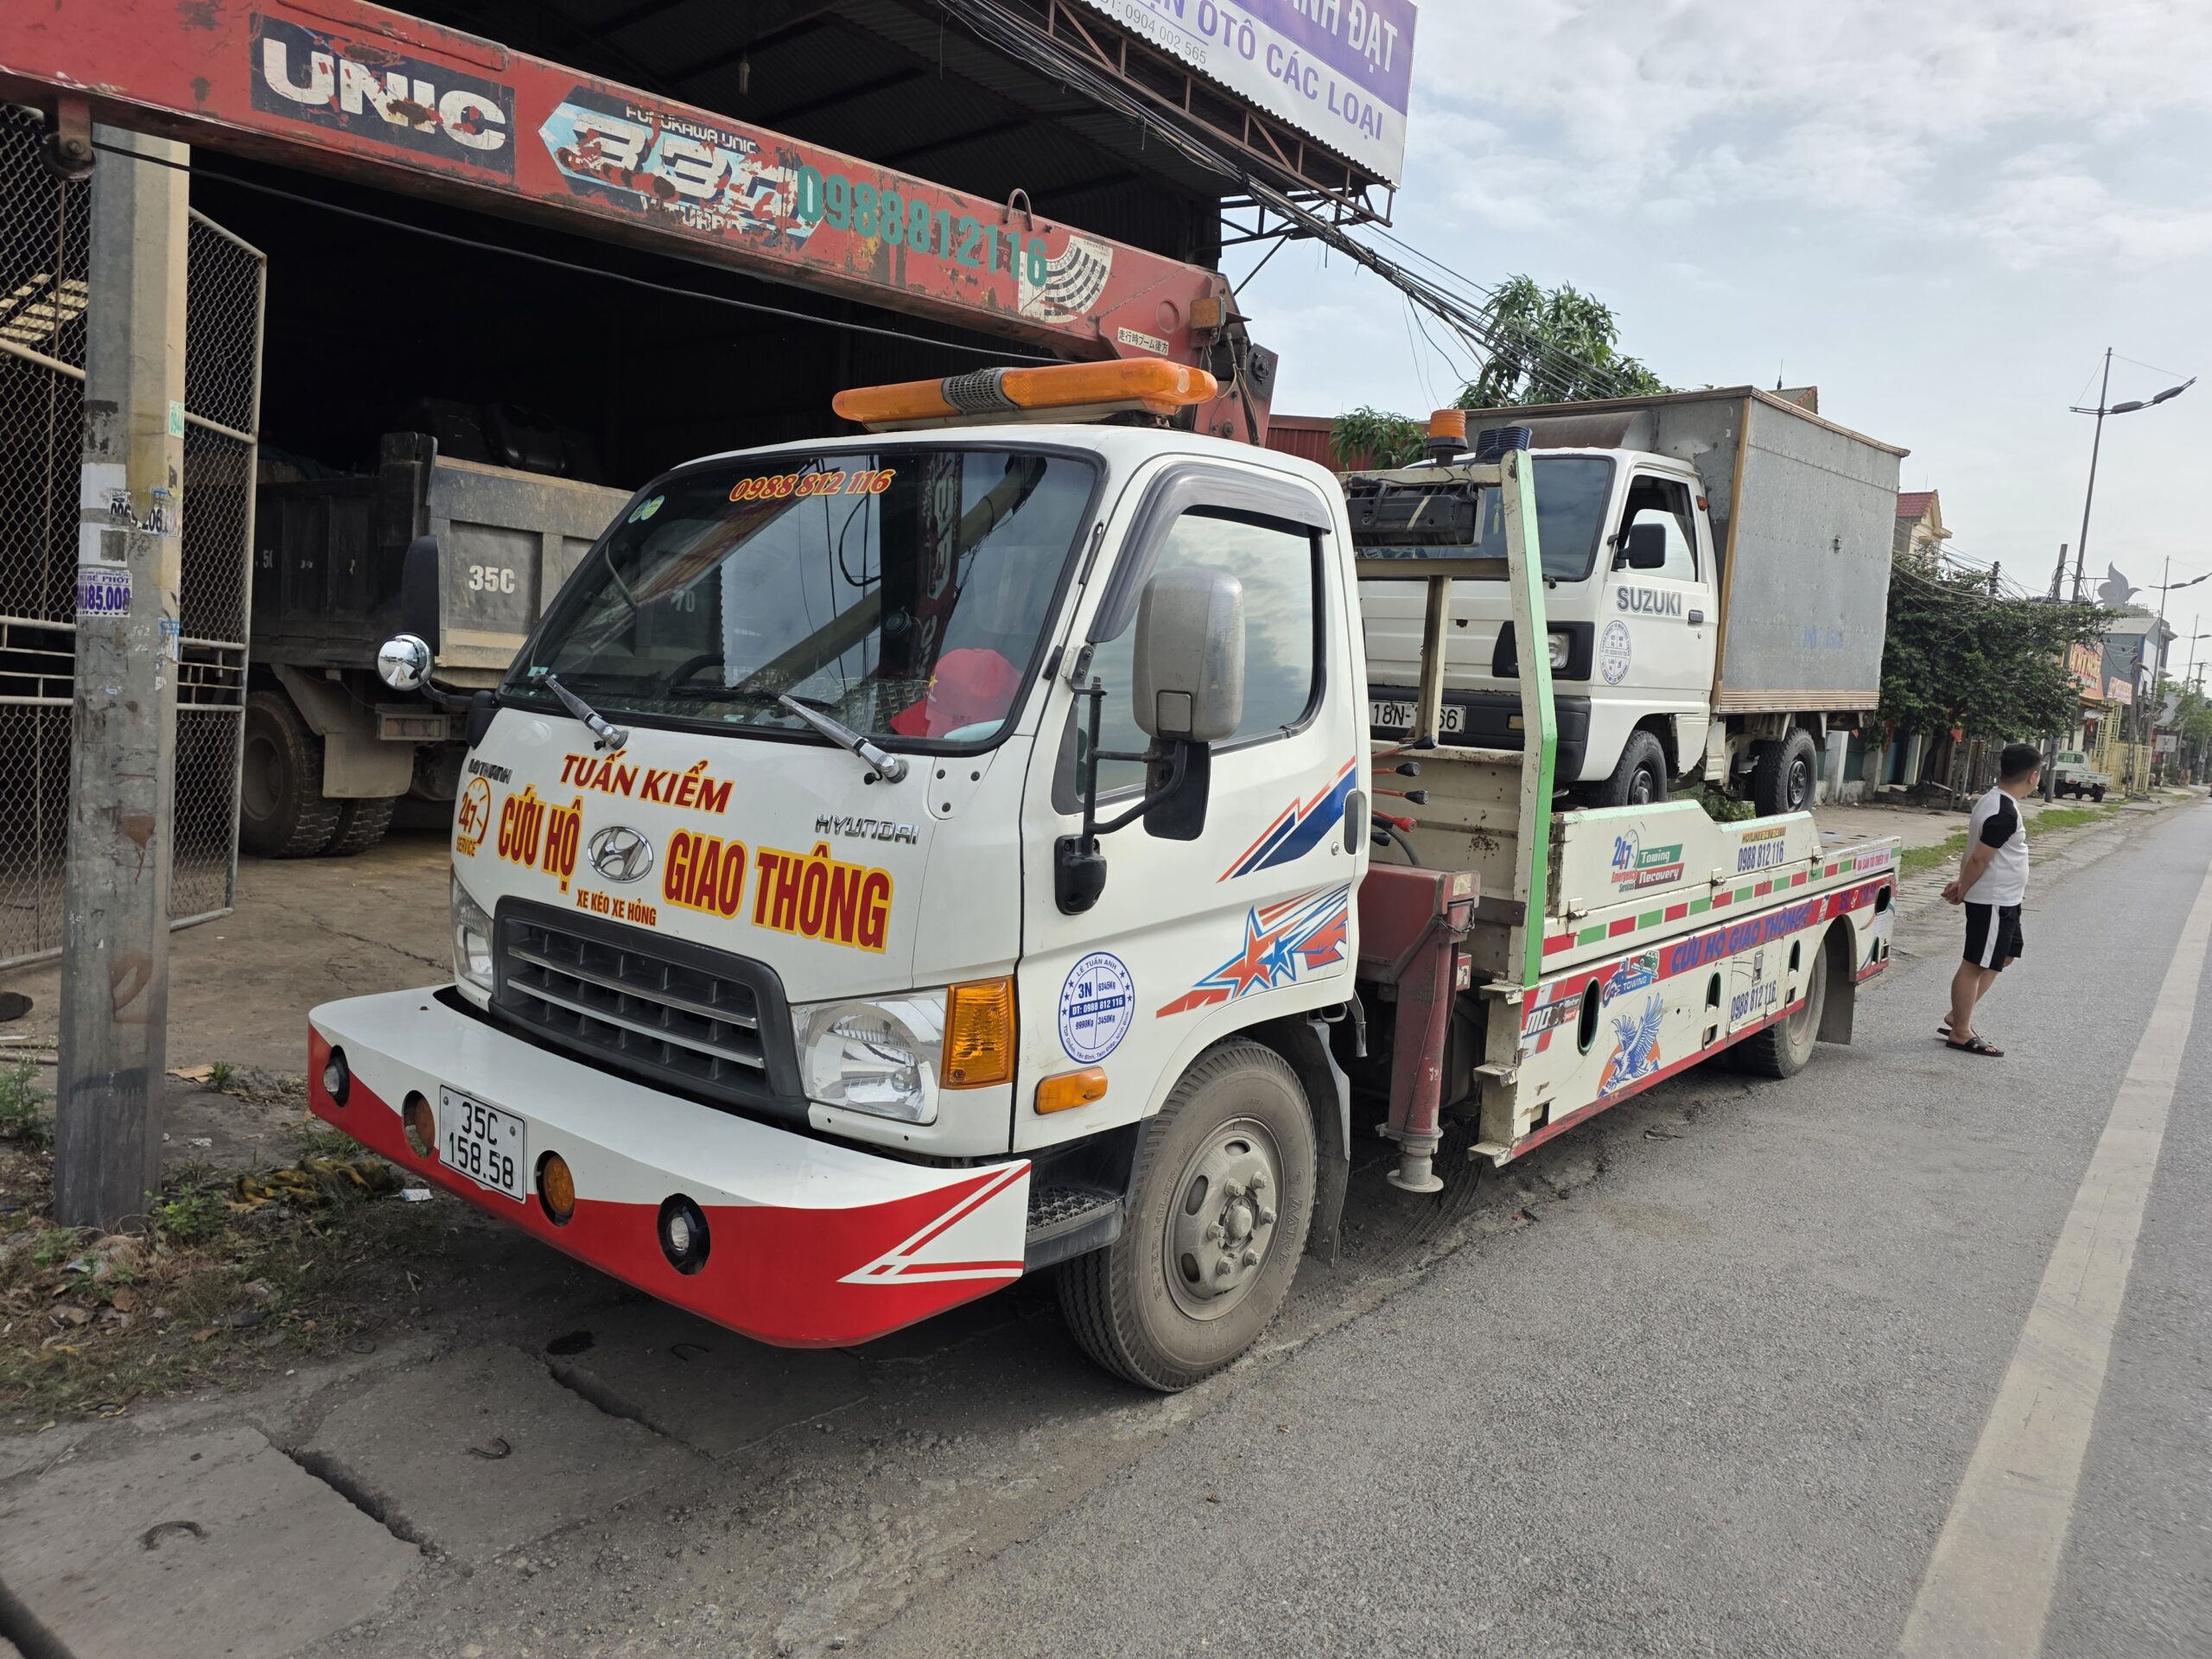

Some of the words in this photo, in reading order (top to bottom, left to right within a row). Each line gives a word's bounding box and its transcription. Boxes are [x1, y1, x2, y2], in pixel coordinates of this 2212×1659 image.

[1125, 3, 1155, 34] 0904
[1159, 25, 1181, 50] 002
[1184, 41, 1206, 65] 565
[1348, 0, 1398, 73] ĐẠT
[1198, 0, 1255, 60] OTÔ
[1267, 43, 1319, 100] CÁC
[1327, 80, 1382, 140] LOẠI
[263, 37, 506, 150] UNIC
[721, 132, 757, 155] UNIC
[797, 164, 1047, 288] 0988812116
[1118, 328, 1168, 353] 走行時ブーム後方
[729, 474, 798, 502] 0988
[795, 471, 847, 497] 812
[844, 468, 896, 495] 116
[468, 565, 515, 594] 35C
[1616, 585, 1682, 617] SUZUKI
[560, 750, 641, 798] TUẤN
[638, 760, 736, 815] KIỂM
[497, 784, 548, 869] CỨU
[541, 795, 584, 895] HỘ
[814, 813, 921, 846] HYUNDAI
[1640, 849, 1671, 864] Towing
[1738, 847, 1757, 872] 0988
[1758, 842, 1771, 868] 812
[1772, 840, 1784, 864] 116
[662, 828, 750, 920] GIAO
[751, 840, 894, 955] THÔNG
[1639, 868, 1681, 885] Recovery
[576, 889, 589, 908] XE
[590, 890, 610, 914] KÉO
[611, 897, 626, 918] XE
[626, 899, 657, 926] HỎNG
[1728, 919, 1762, 951] GIAO
[1076, 965, 1085, 978] LÊ
[1085, 957, 1103, 969] TUẤN
[1103, 959, 1117, 969] ANH
[1623, 976, 1648, 991] TOWING
[1077, 982, 1093, 999] 3N
[1083, 1002, 1099, 1014] 0988
[1099, 999, 1112, 1010] 812
[1111, 996, 1124, 1007] 116
[1731, 996, 1750, 1020] 0988
[1750, 988, 1764, 1011] 812
[1764, 980, 1777, 1005] 116
[461, 1101, 499, 1147] 35C
[448, 1131, 515, 1191] 158.58
